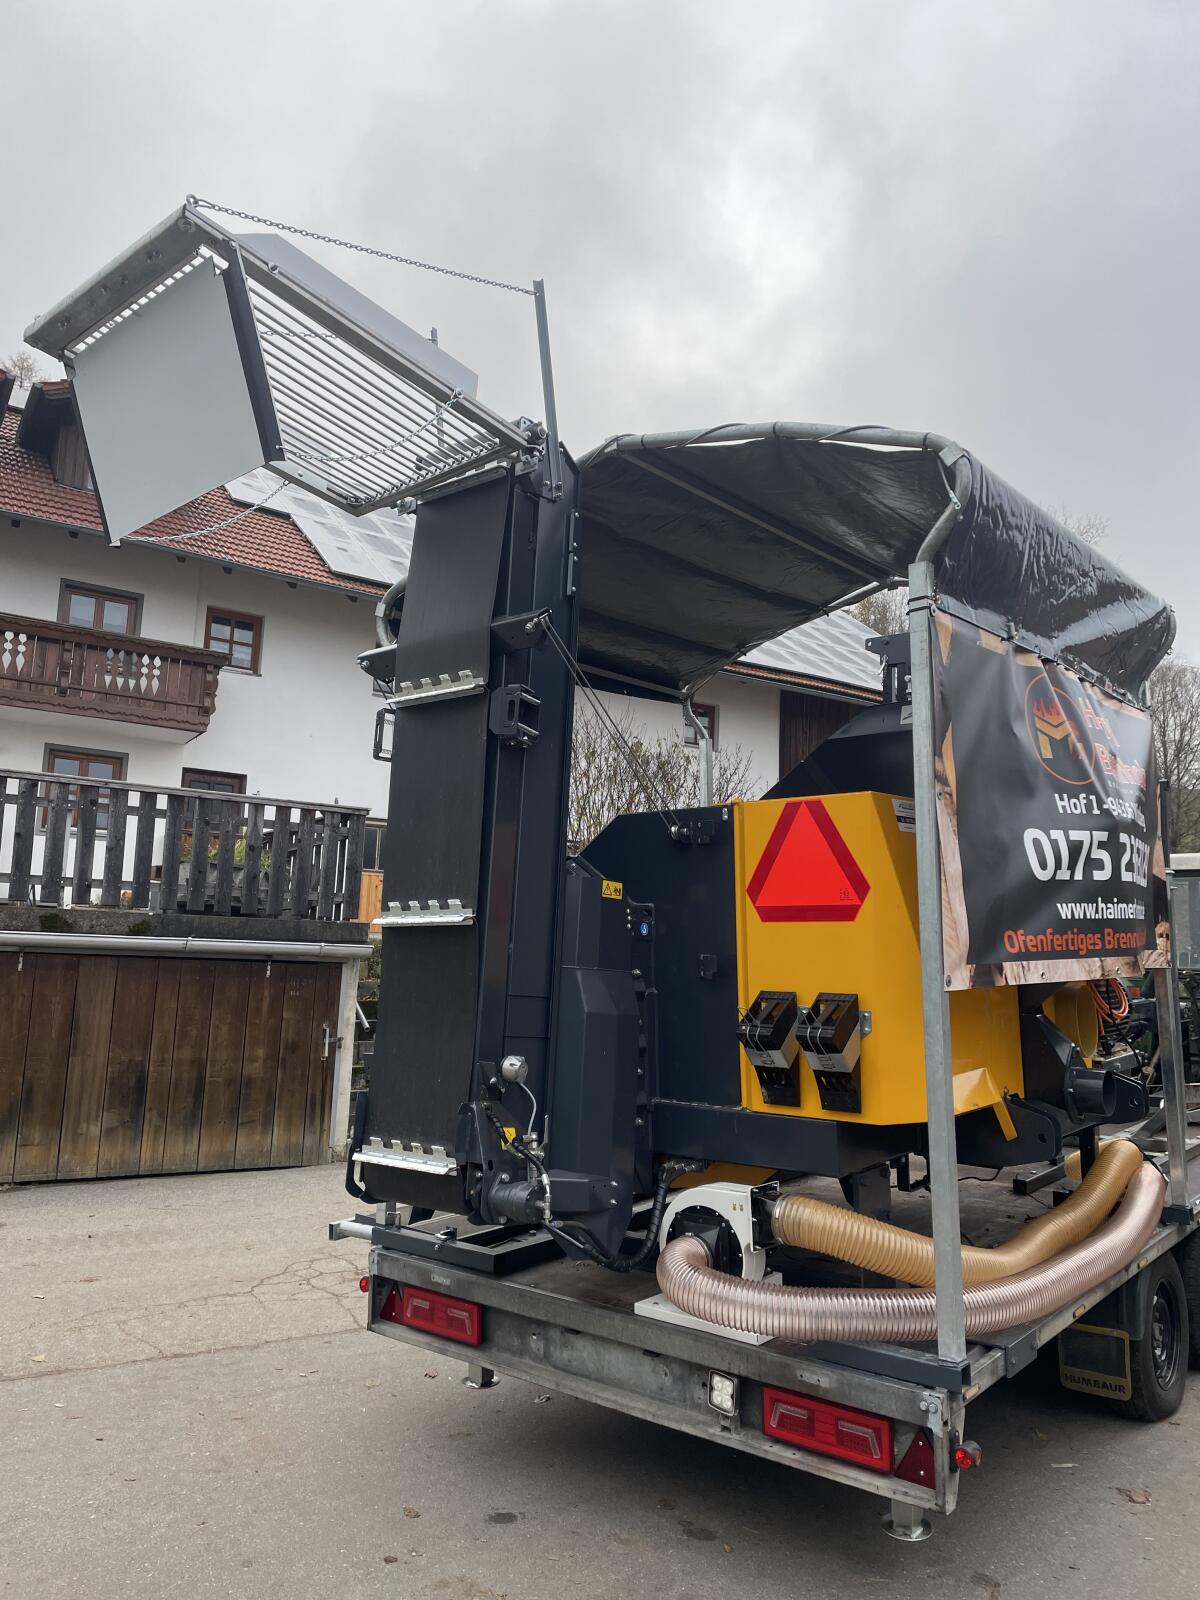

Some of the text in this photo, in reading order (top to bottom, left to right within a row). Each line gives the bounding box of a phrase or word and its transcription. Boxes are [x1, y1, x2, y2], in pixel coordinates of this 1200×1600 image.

[1054, 793, 1087, 815] Hof
[1090, 795, 1101, 815] 1
[1023, 827, 1113, 882] 0175
[1003, 928, 1102, 956] Ofenfertiges
[1062, 1372, 1127, 1395] HUMBAUR
